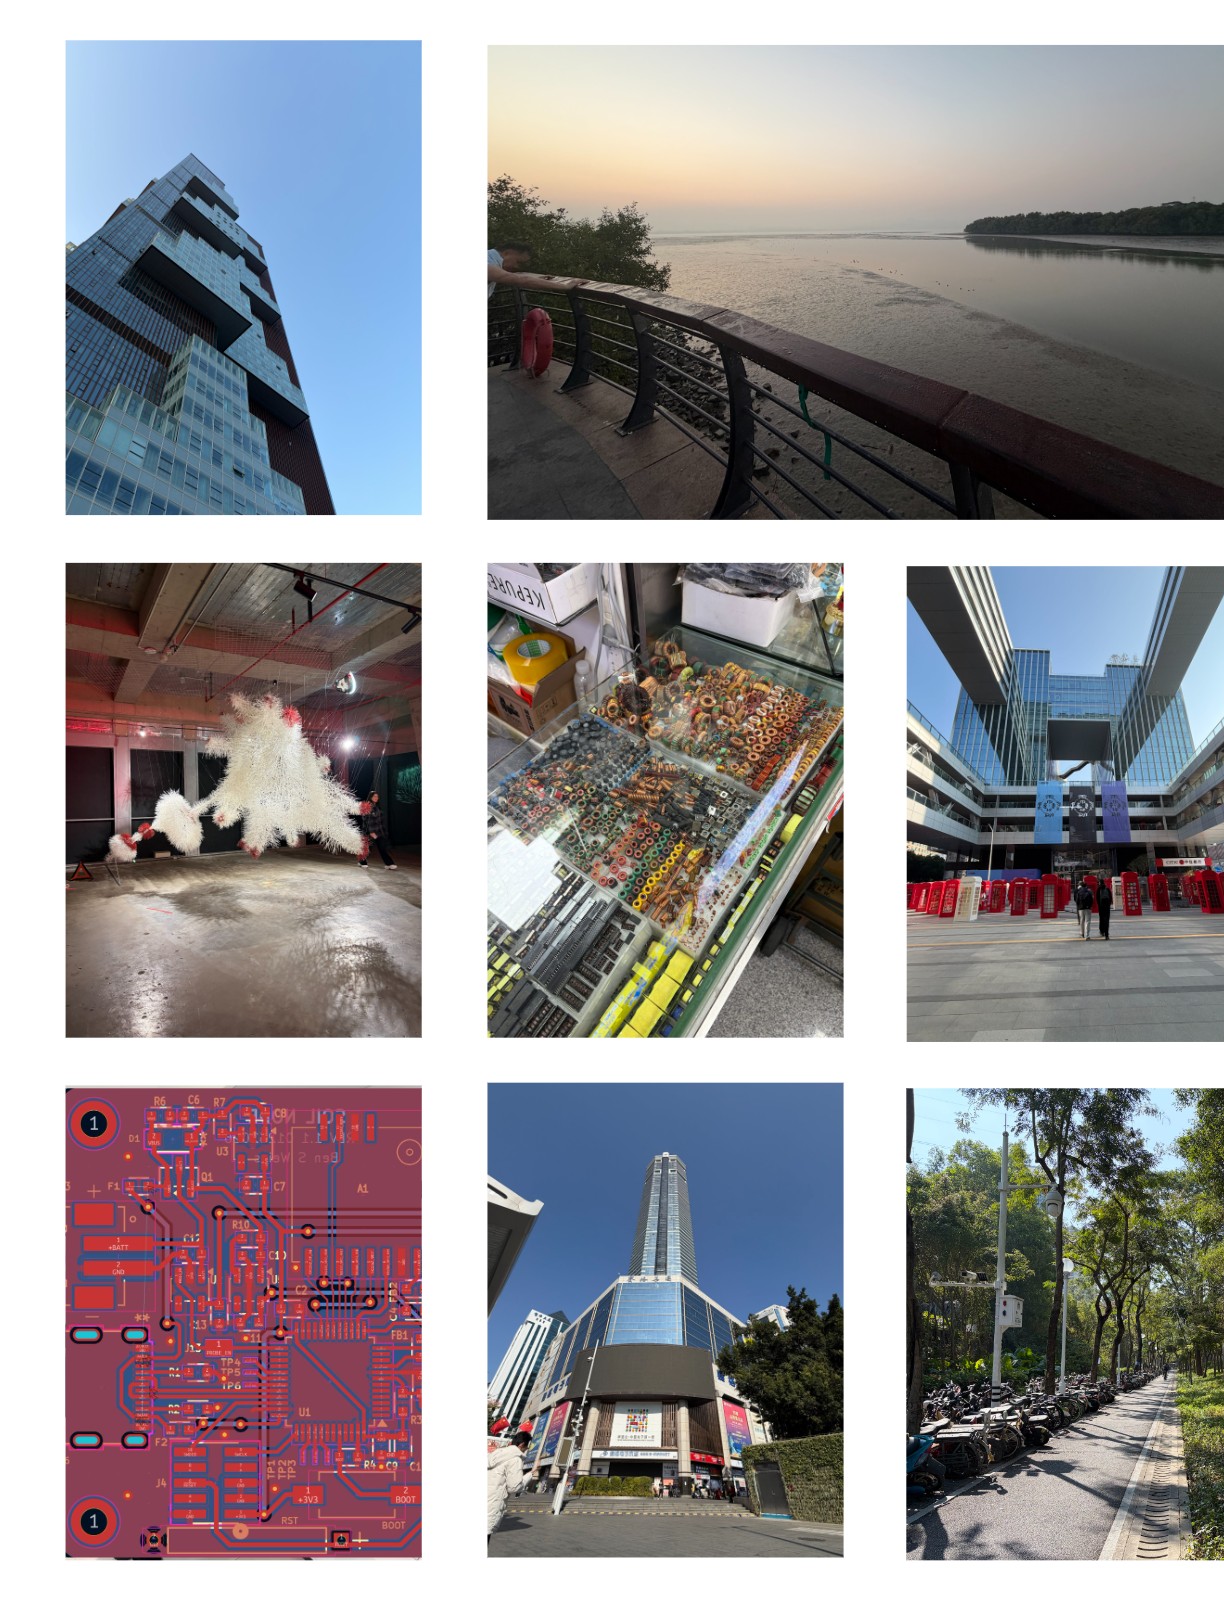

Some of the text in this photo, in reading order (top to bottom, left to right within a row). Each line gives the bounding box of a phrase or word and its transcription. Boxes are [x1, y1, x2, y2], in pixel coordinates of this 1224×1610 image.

[488, 573, 546, 611] KEPURE
[154, 1096, 166, 1106] R6
[188, 1095, 200, 1105] C6
[213, 1098, 226, 1107] R7
[274, 1108, 287, 1118] C8
[90, 1116, 98, 1131] 1
[129, 1135, 140, 1143] D1
[216, 1147, 229, 1156] U3
[201, 1172, 213, 1182] Q1
[108, 1182, 120, 1190] F1
[273, 1182, 286, 1191] C7
[357, 1184, 368, 1193] A1
[232, 1220, 250, 1229] R10
[295, 1285, 308, 1295] C2
[392, 1330, 408, 1340] FB1
[221, 1358, 241, 1366] TP4
[221, 1368, 241, 1376] TP5
[299, 1408, 311, 1417] U1
[155, 1438, 168, 1446] F2
[364, 1460, 376, 1469] R4
[386, 1461, 398, 1471] C9
[267, 1460, 276, 1479] TP1
[278, 1460, 287, 1479] TP2
[287, 1460, 297, 1479] TP3
[156, 1478, 167, 1488] J4
[298, 1496, 319, 1504] +3V3
[395, 1496, 416, 1504] BOOT
[90, 1514, 98, 1528] 1
[281, 1517, 298, 1525] RST
[382, 1521, 406, 1529] BOOT
